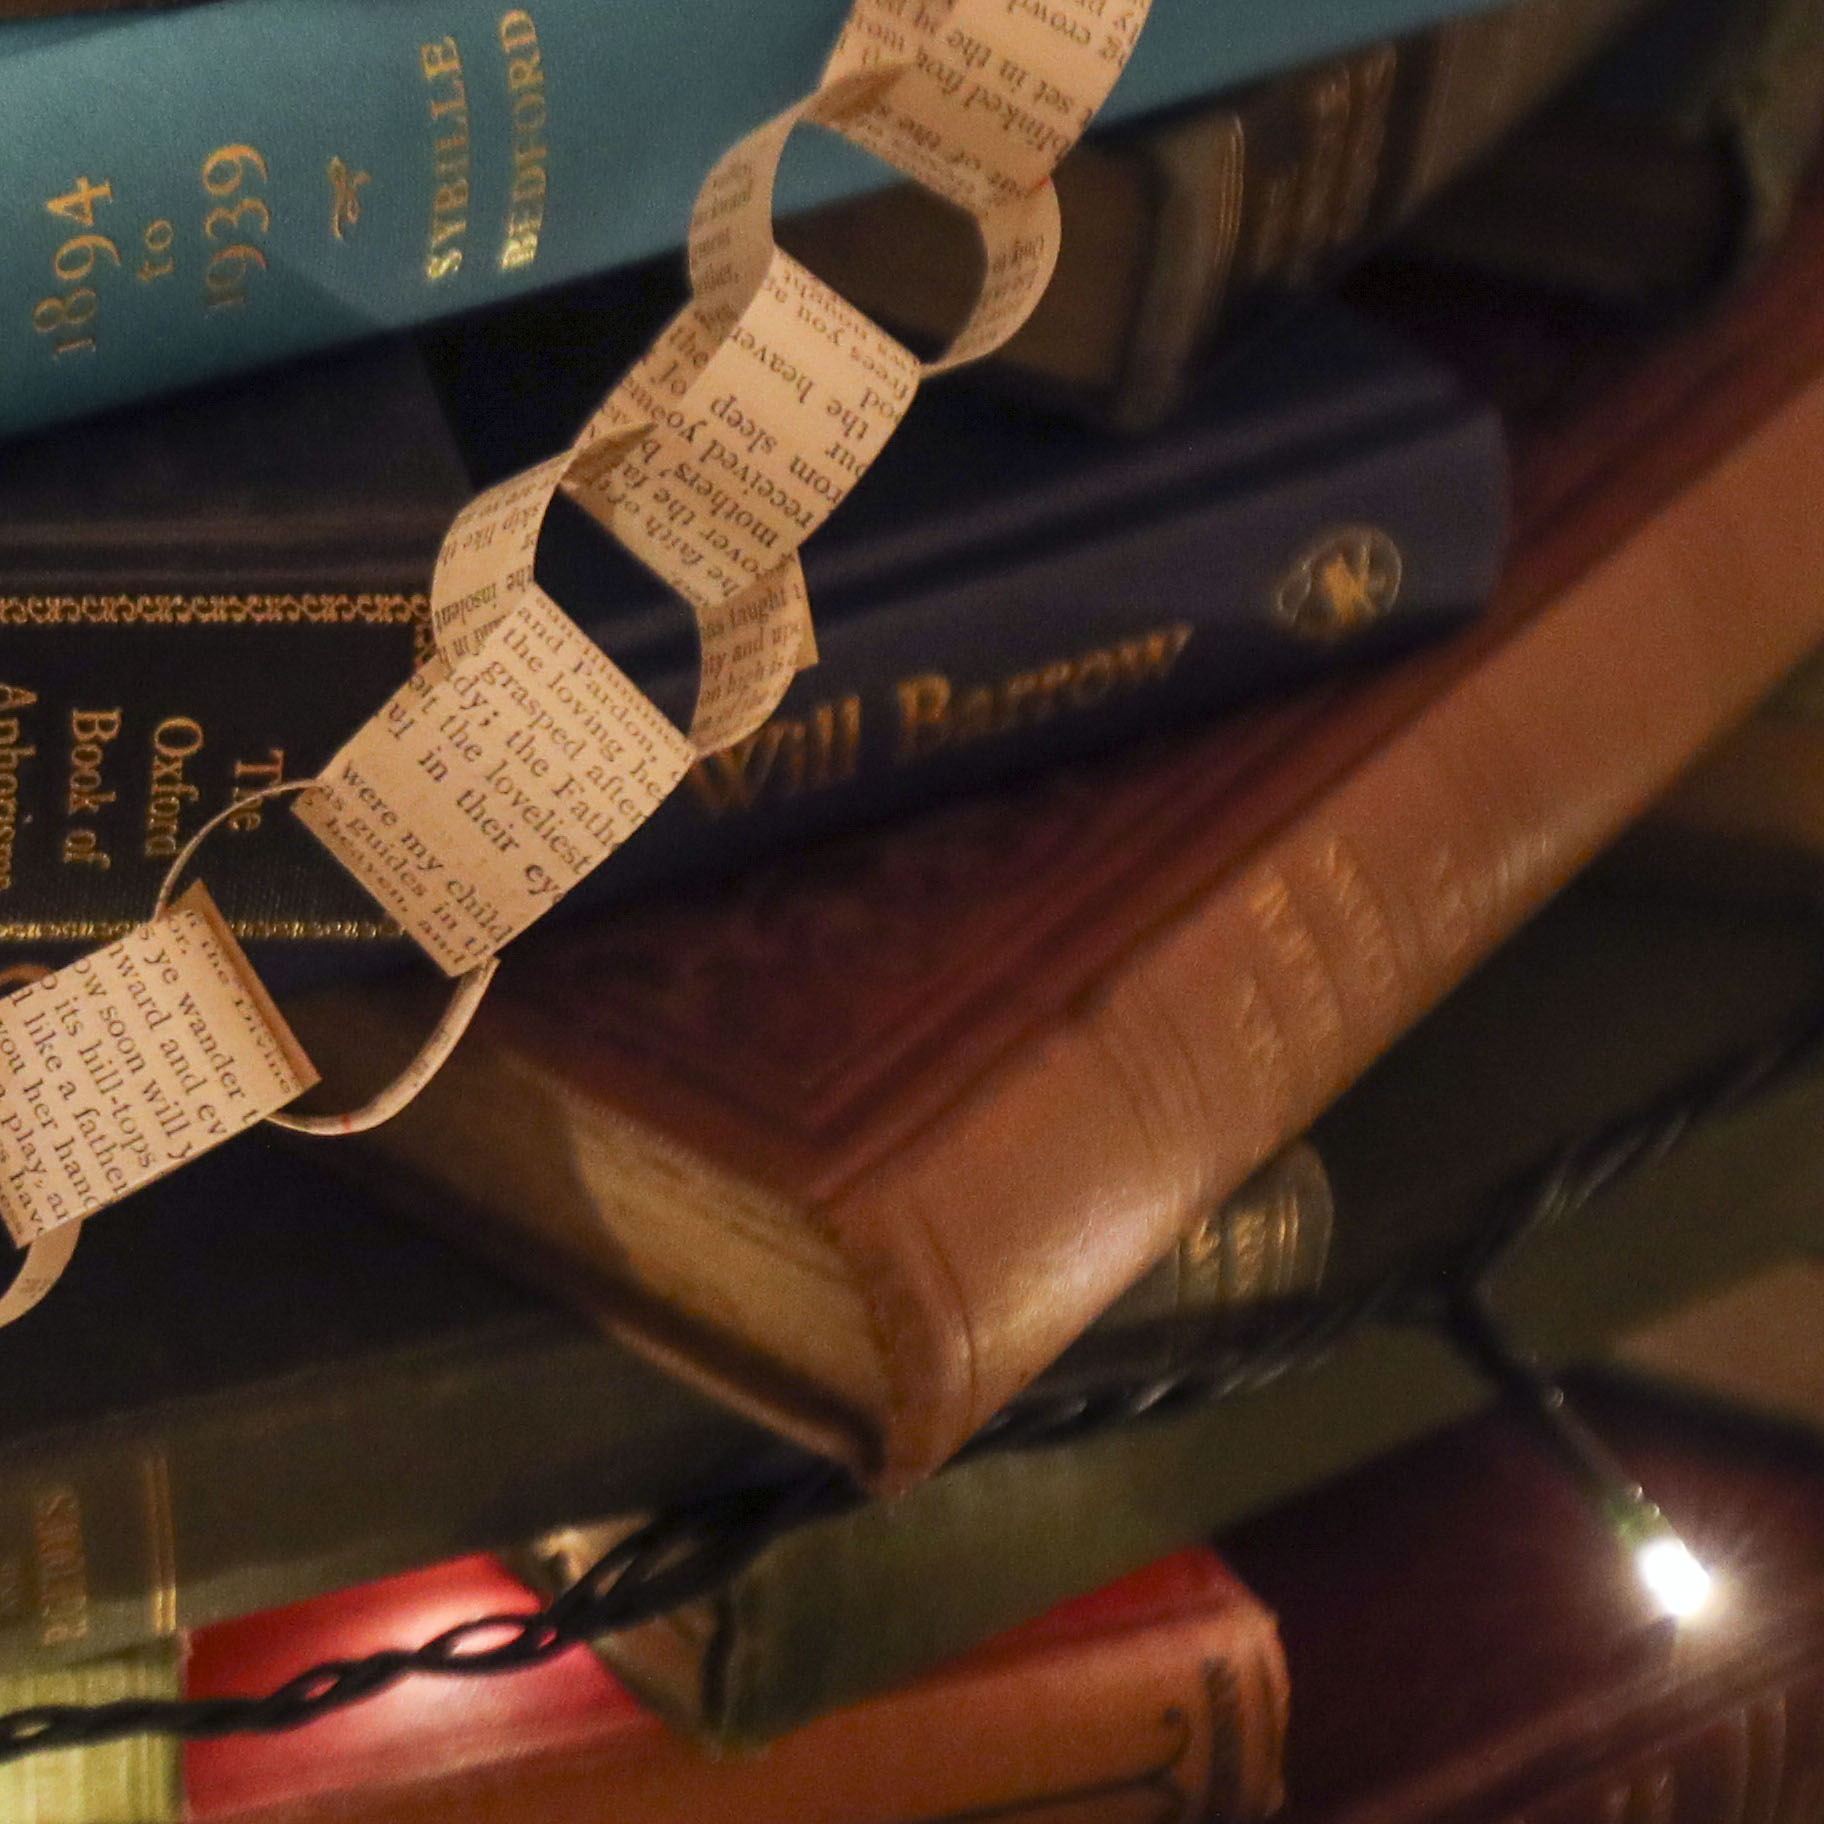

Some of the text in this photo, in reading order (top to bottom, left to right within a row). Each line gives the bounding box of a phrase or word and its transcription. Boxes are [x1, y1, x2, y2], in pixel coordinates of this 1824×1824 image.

[422, 35, 471, 284] SYBILLE
[498, 9, 546, 275] BEDFORD
[34, 176, 122, 360] 1894
[137, 220, 174, 284] to
[203, 143, 268, 310] 1939
[698, 439, 814, 530] received
[701, 394, 778, 454] sleep
[471, 660, 587, 762] grasped
[505, 730, 549, 778] the
[546, 671, 625, 763] loving
[62, 706, 123, 871] Book of
[144, 714, 204, 858] Oxford
[341, 761, 453, 883] were my
[417, 751, 520, 853] in their
[439, 715, 591, 875] the loveliest
[23, 1012, 63, 1073] like
[54, 996, 151, 1169] its hill-tops
[98, 1005, 191, 1138] soon will
[143, 948, 246, 1099] ye wander
[159, 1038, 208, 1096] and
[22, 1078, 58, 1129] her
